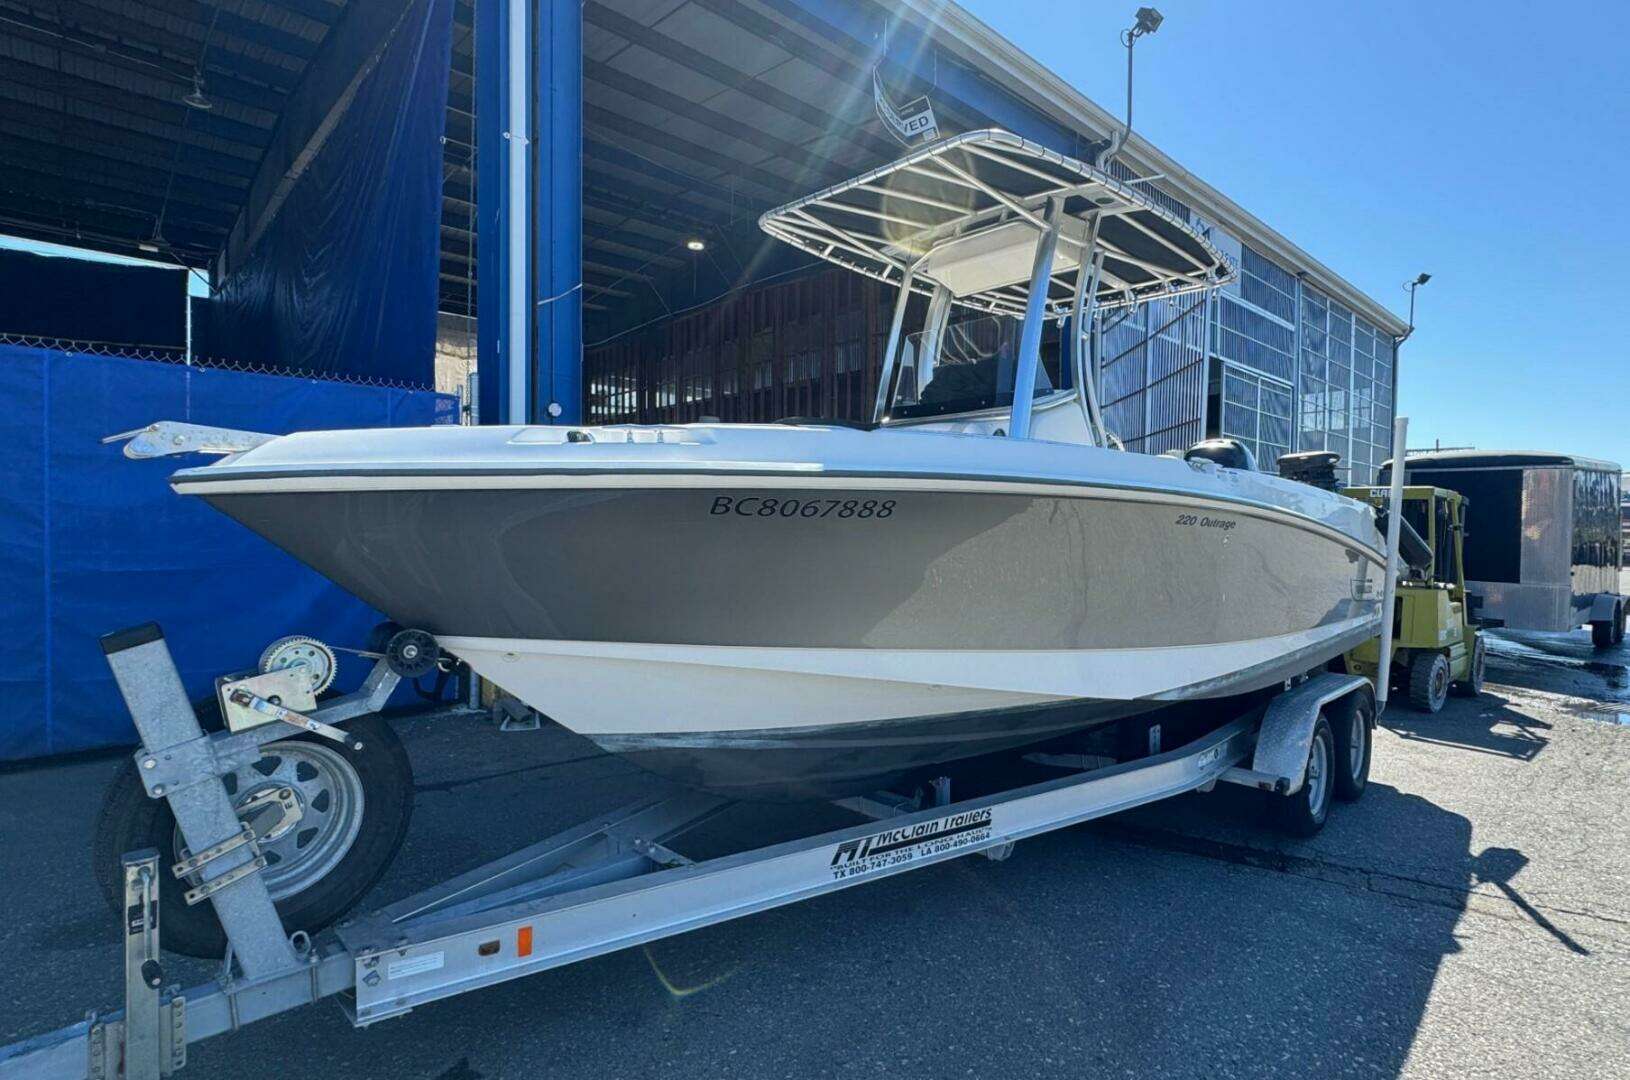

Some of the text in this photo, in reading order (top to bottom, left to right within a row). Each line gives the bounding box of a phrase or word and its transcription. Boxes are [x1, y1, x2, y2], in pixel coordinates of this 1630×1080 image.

[710, 496, 897, 518] BC8067888
[1175, 514, 1236, 530] 220 Outrage
[877, 808, 992, 846] McClain Trailers
[833, 869, 846, 879] TX
[921, 847, 932, 856] LA
